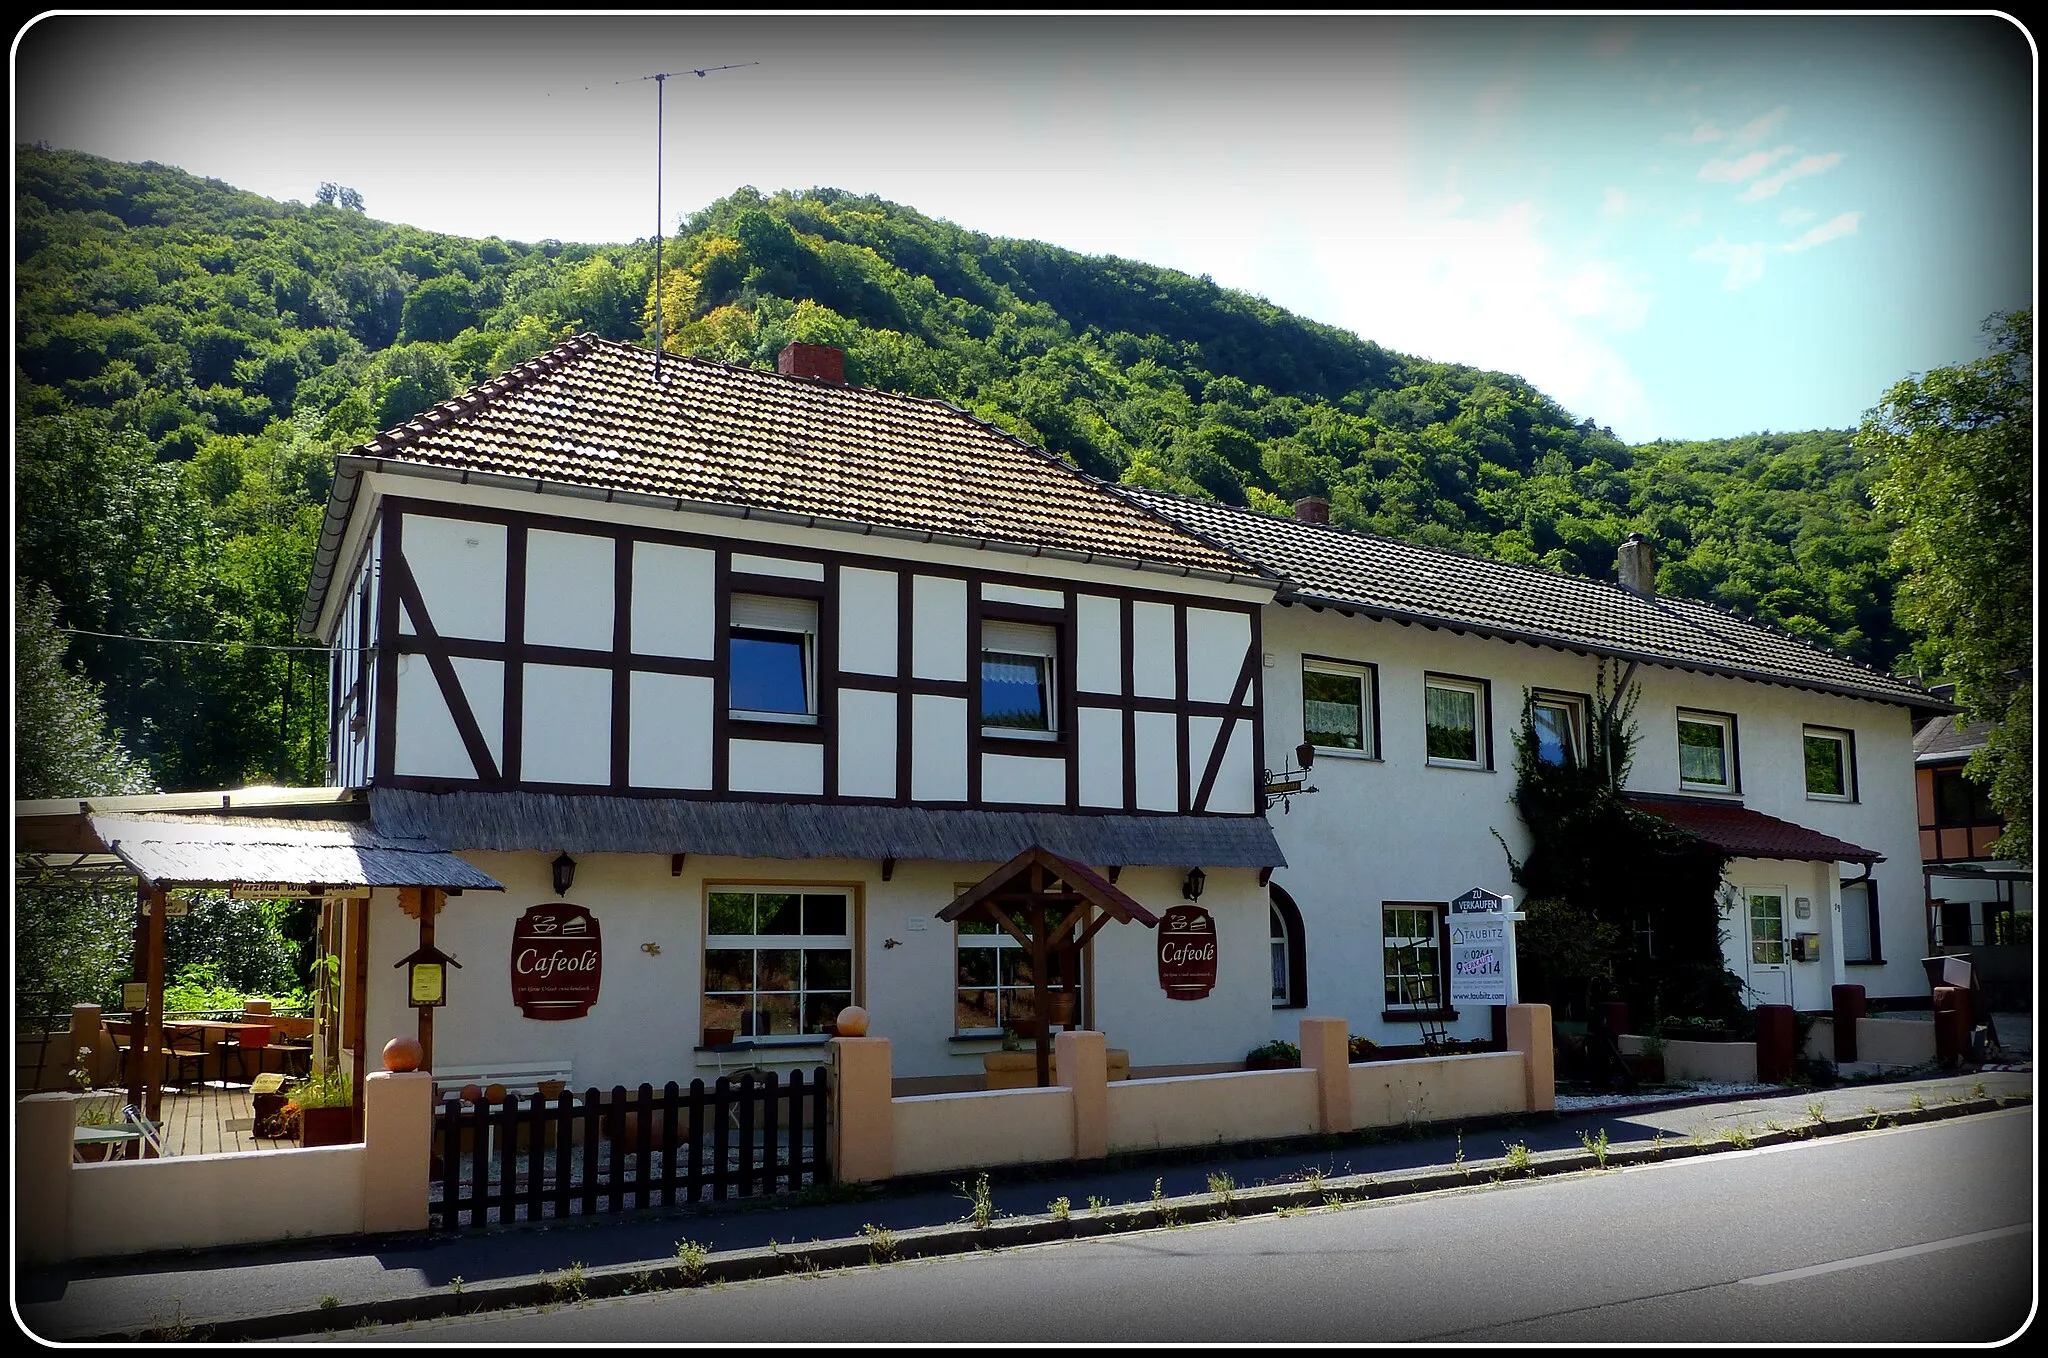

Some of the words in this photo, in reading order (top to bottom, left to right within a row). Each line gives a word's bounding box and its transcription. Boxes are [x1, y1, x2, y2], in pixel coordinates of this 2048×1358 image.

[1472, 890, 1482, 899] ZU
[1458, 900, 1498, 910] VERKAUFEN
[1464, 929, 1503, 940] TAUBITZ
[1161, 941, 1215, 967] Cafeolé
[516, 948, 598, 979] Cafeolé
[1462, 954, 1493, 972] VERKAUFT
[1480, 960, 1501, 975] 314
[1452, 990, 1505, 1000] www.taubitz.com
